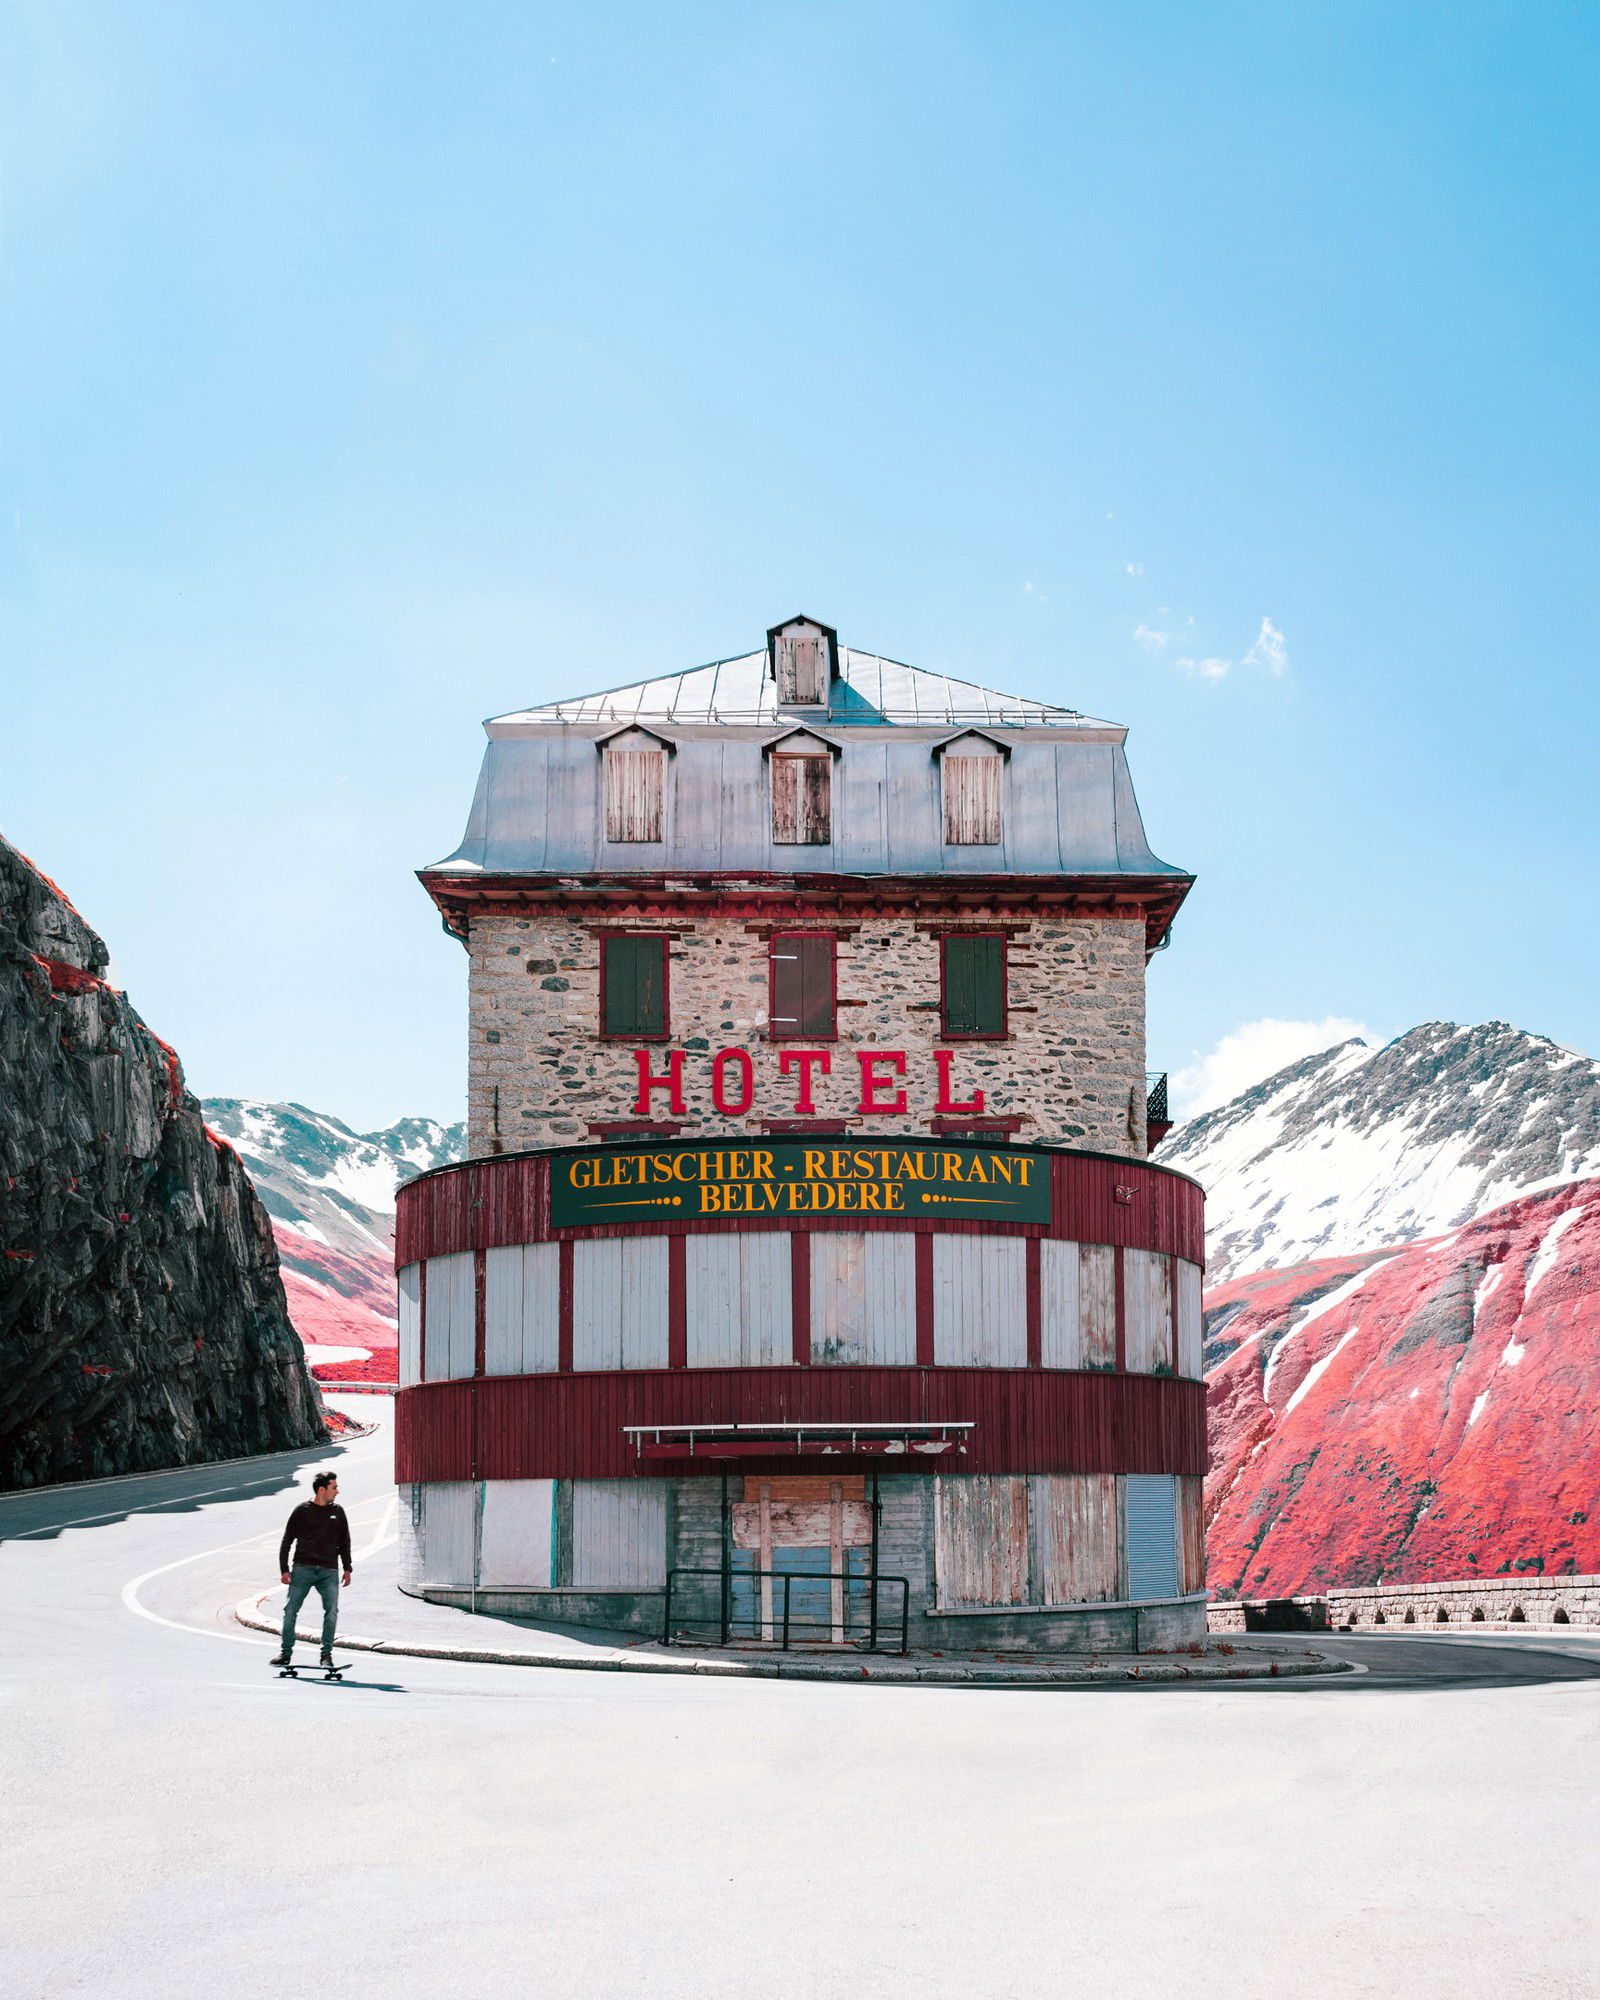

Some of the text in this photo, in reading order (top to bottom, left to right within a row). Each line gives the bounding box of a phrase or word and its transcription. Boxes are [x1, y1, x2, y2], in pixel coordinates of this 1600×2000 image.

[634, 1047, 985, 1115] HOTEL
[569, 1150, 777, 1189] GLETSCHER
[802, 1149, 1035, 1187] RESTAURANT
[698, 1182, 905, 1213] BELVEDERE
